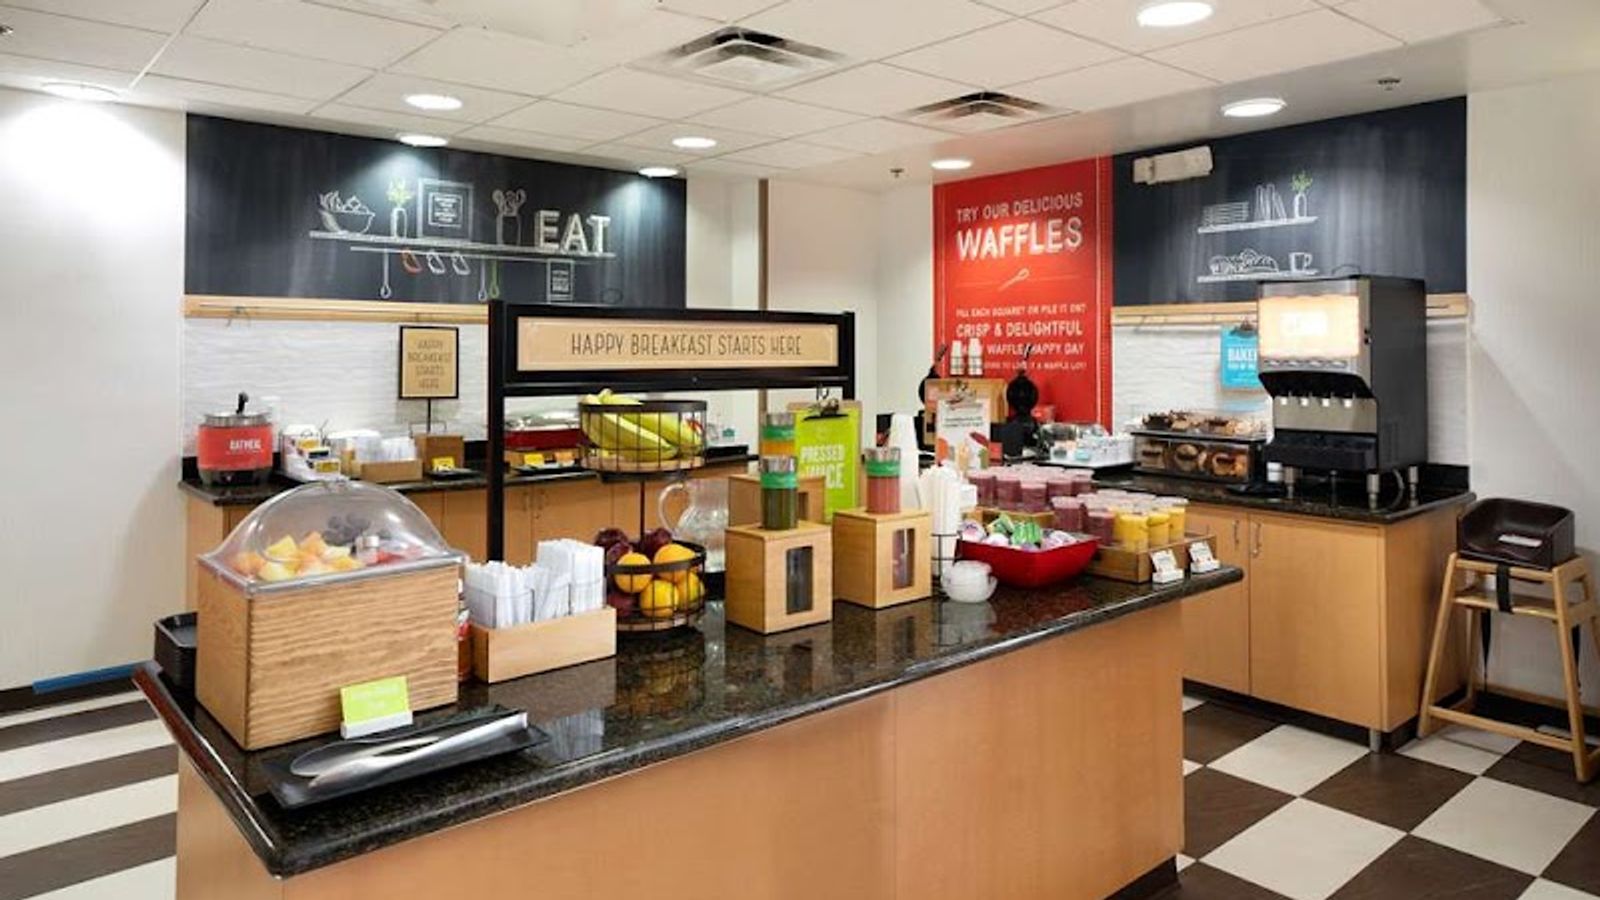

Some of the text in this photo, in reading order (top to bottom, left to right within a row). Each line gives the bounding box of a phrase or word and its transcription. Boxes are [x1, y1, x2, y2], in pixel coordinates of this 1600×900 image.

[957, 192, 1083, 222] TRY OUR DELICIOUS
[535, 210, 611, 257] EAT
[957, 217, 1082, 261] WAFFLES
[956, 319, 1083, 338] CRISP & DELIGHTFUL
[571, 333, 802, 356] HAPPY BREAKFAST STARTS HERE
[1064, 341, 1085, 354] DAY
[800, 445, 845, 463] PRESSED
